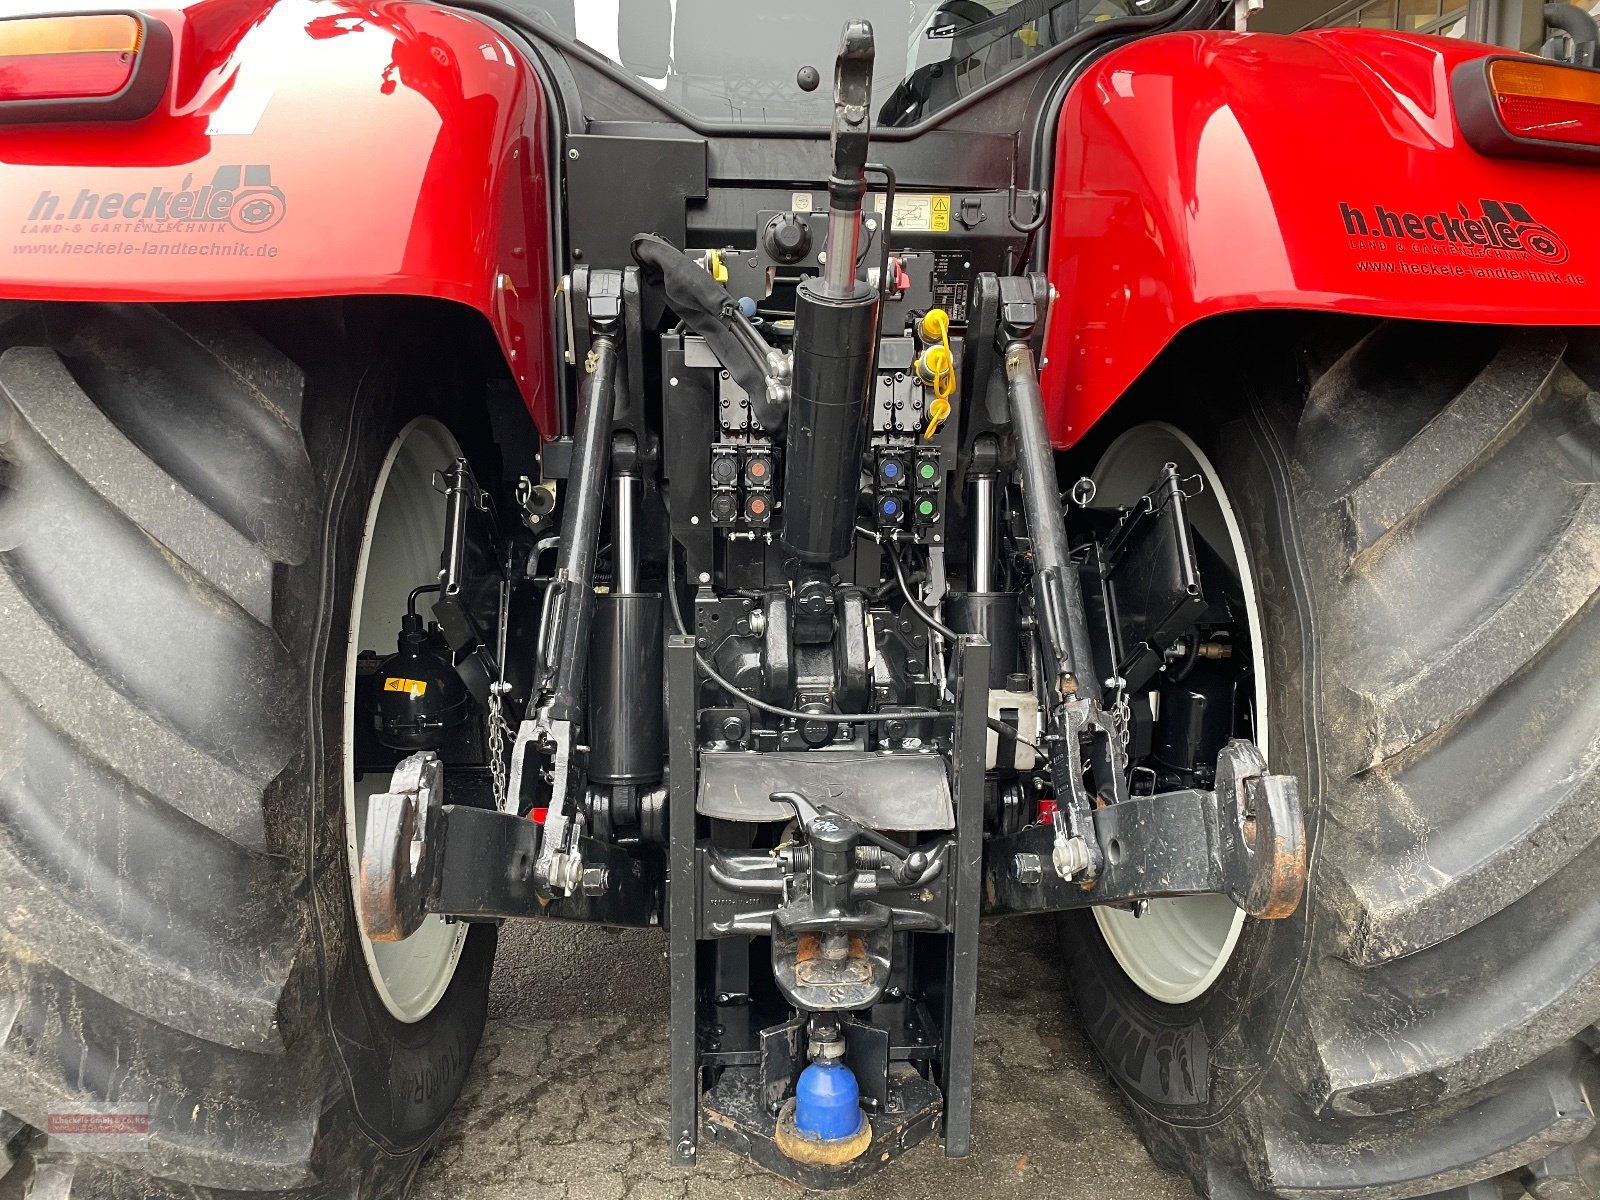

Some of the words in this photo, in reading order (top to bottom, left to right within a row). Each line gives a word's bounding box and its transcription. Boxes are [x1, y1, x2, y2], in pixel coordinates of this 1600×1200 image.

[90, 223, 227, 233] GARTENTECHNIK
[12, 241, 278, 258] www.heckele-landtechnik.de
[1349, 239, 1387, 251] LAND
[1396, 242, 1405, 252] &
[1413, 243, 1531, 262] GARTENTECHNIK
